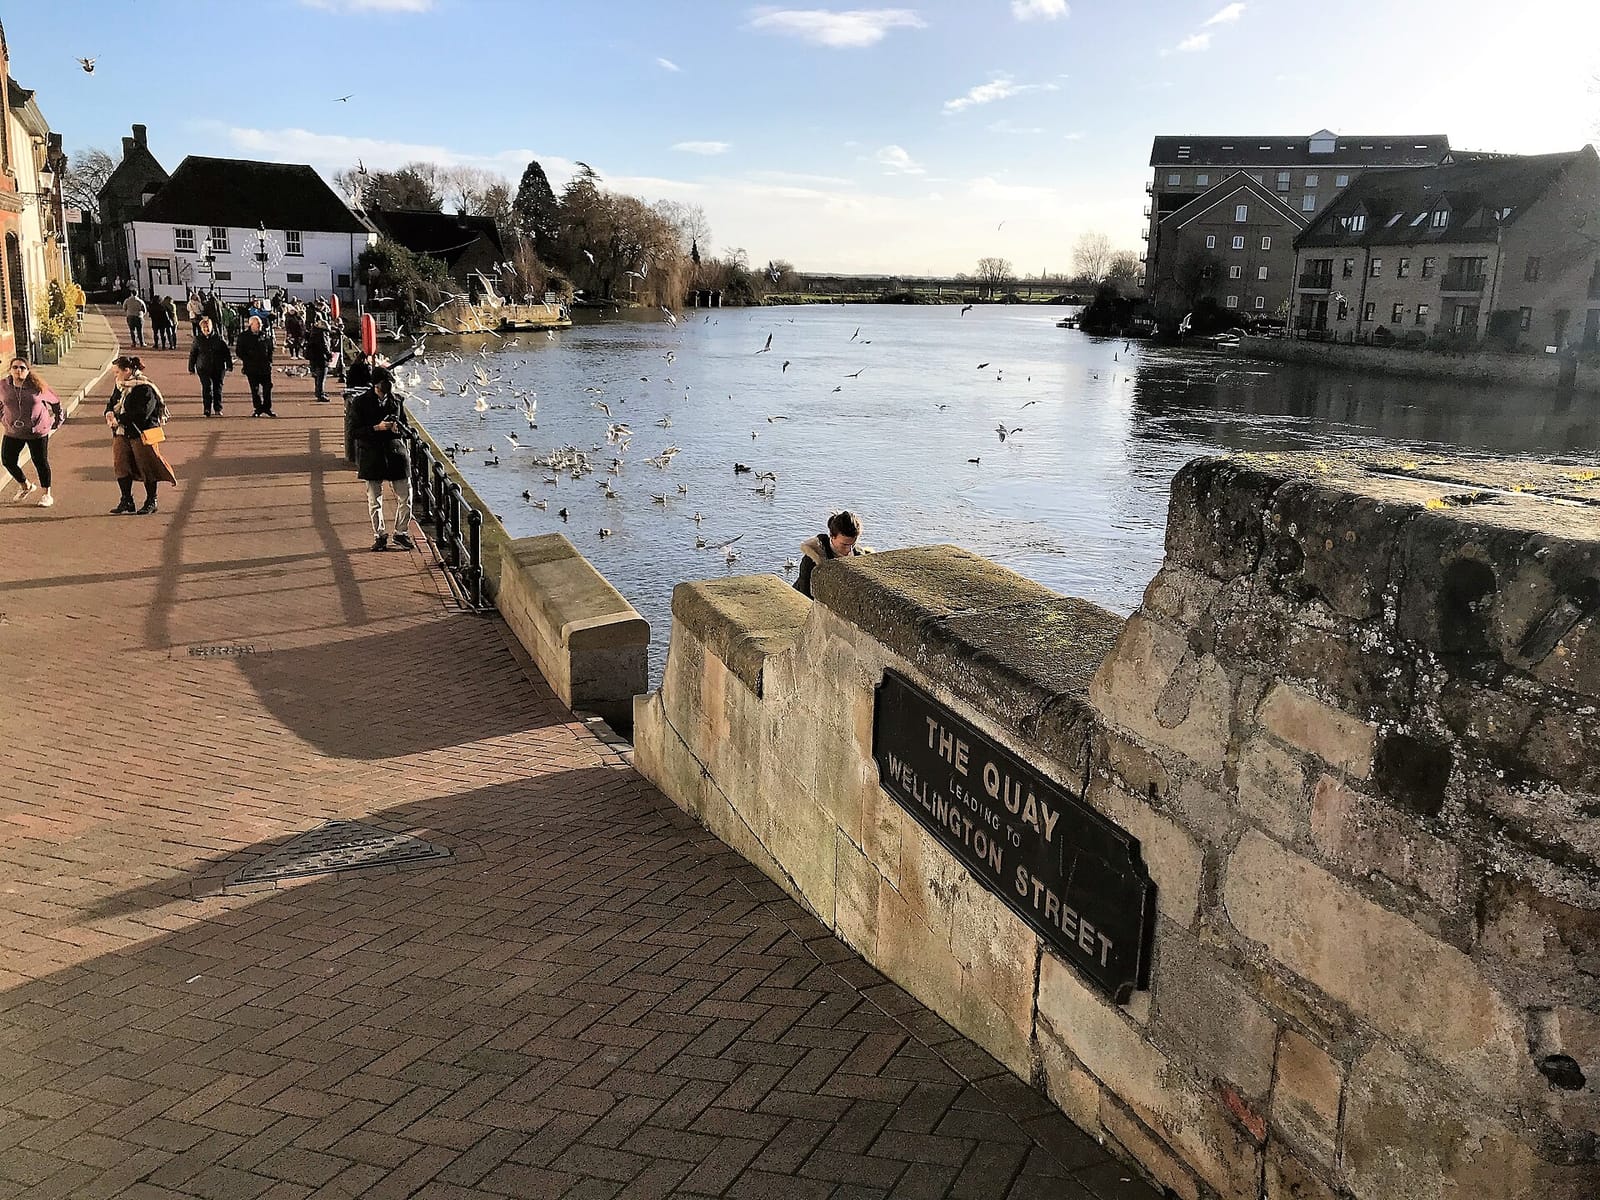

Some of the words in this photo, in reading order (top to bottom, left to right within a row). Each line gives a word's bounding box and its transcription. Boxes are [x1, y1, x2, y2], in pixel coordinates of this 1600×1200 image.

[925, 716, 968, 776] THE
[983, 761, 1060, 842] QUAY
[949, 778, 1000, 830] LEADING
[1006, 824, 1020, 848] TO
[887, 752, 1002, 874] WELLINGTON
[1015, 865, 1113, 968] STREET
